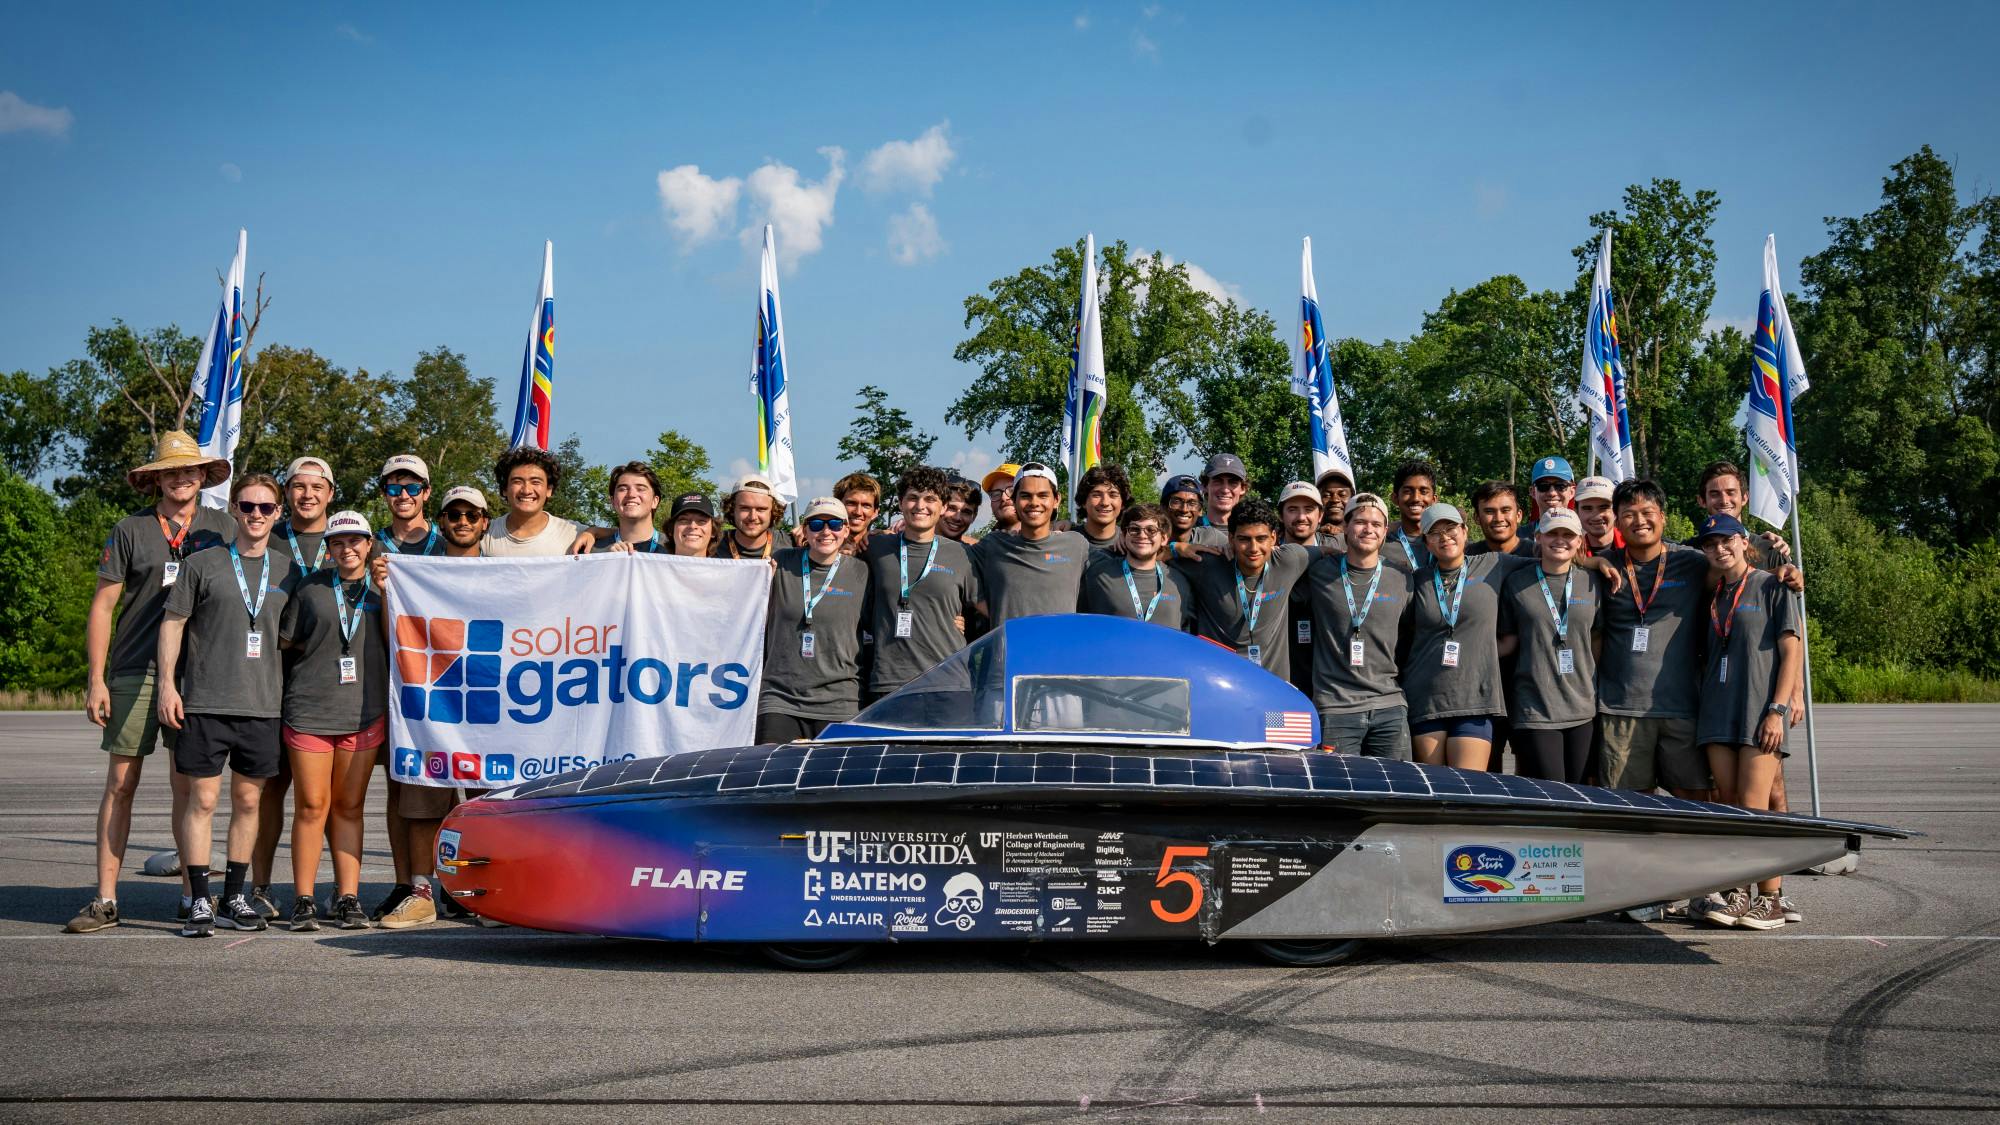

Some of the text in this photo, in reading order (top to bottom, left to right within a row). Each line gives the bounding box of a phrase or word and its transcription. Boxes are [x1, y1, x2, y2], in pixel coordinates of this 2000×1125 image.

[331, 517, 360, 529] FLORIDA
[510, 617, 618, 656] solar
[507, 645, 749, 724] gators
[860, 832, 966, 846] UNIVERSITY of
[980, 832, 1002, 848] UF
[1006, 832, 1069, 840] Herbert Wertheim
[805, 831, 850, 863] UF
[1005, 841, 1032, 850] College
[1042, 841, 1085, 850] Engineering
[1096, 846, 1124, 855] DigiKey
[1519, 844, 1582, 858] electrek
[860, 844, 976, 865] FLORIDA
[1095, 858, 1122, 866] Walmart
[630, 867, 747, 891] FLARE
[831, 872, 926, 892] BATEMO
[1150, 846, 1209, 923] 5
[831, 895, 926, 903] UNDERSTANDING BATTERIES
[827, 913, 883, 926] ALTAIR
[894, 911, 927, 927] Royal
